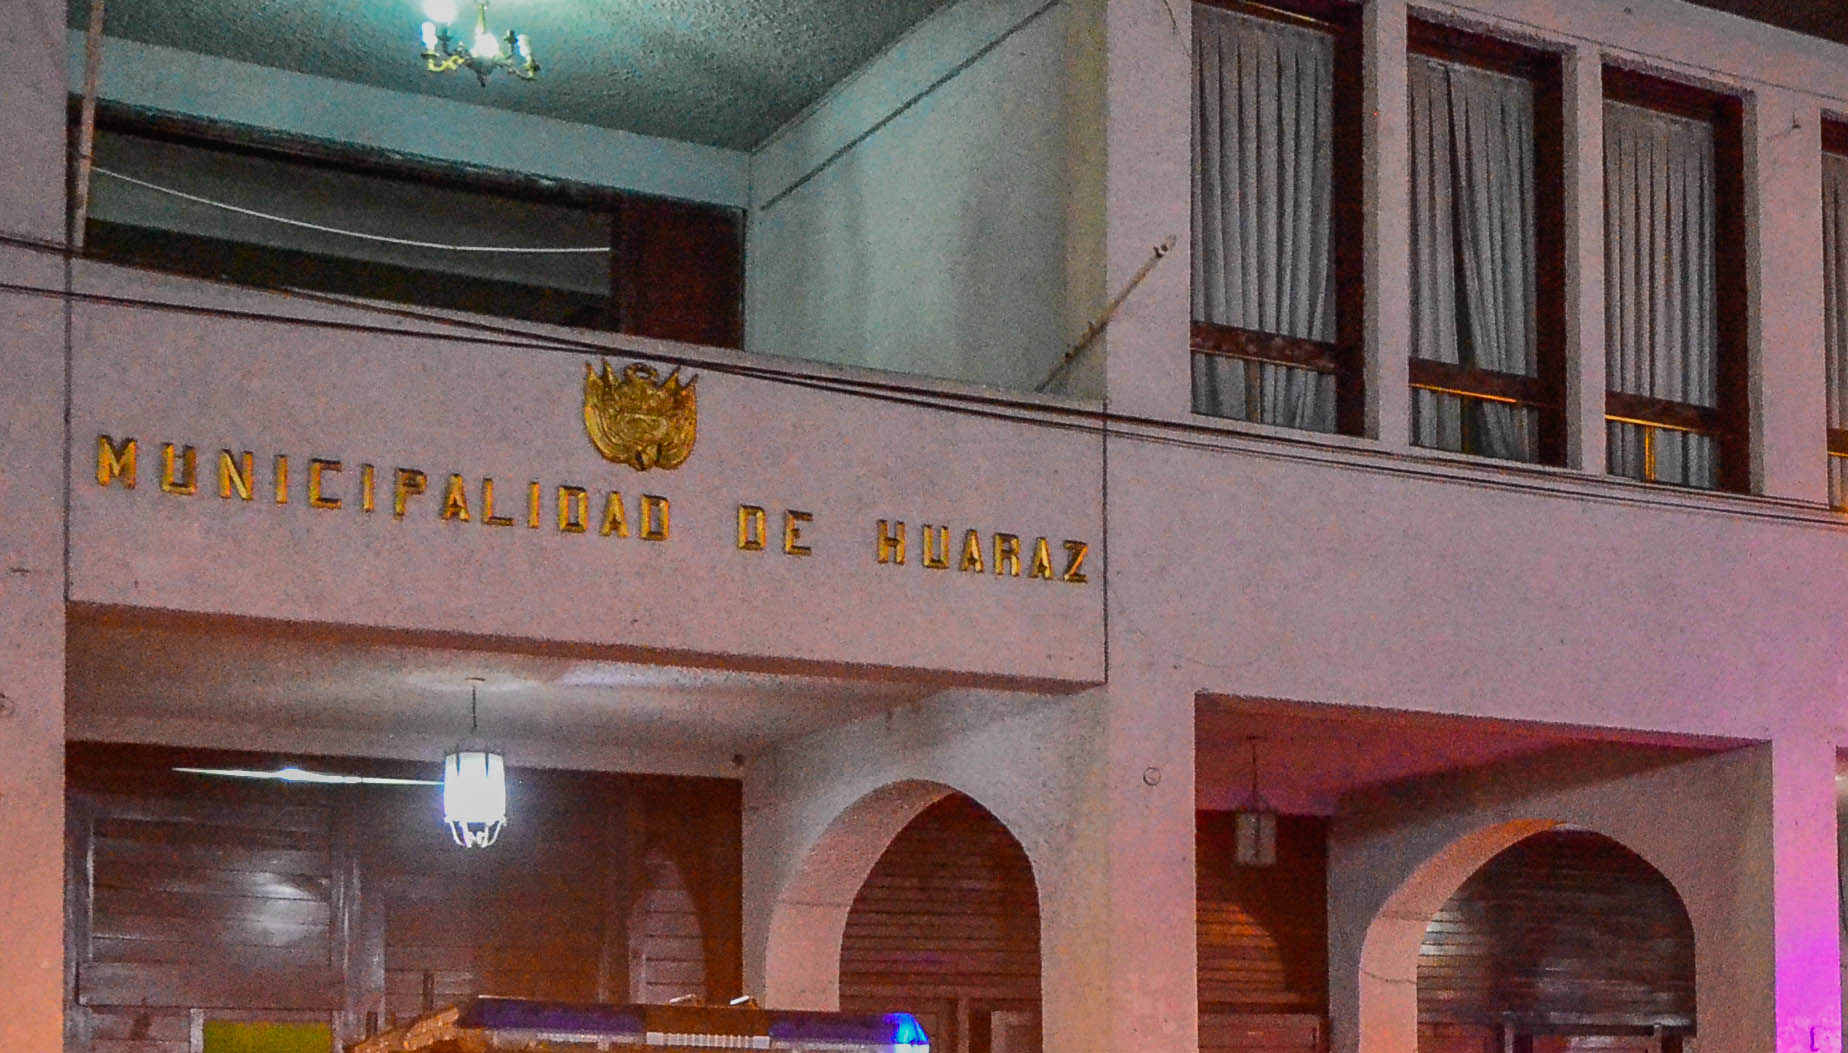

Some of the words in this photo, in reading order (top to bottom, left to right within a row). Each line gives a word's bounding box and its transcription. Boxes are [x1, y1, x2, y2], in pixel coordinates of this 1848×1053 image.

[95, 434, 670, 544] MUNICIPALIDAD
[736, 503, 813, 557] DE
[876, 518, 1089, 584] HUARAZ
